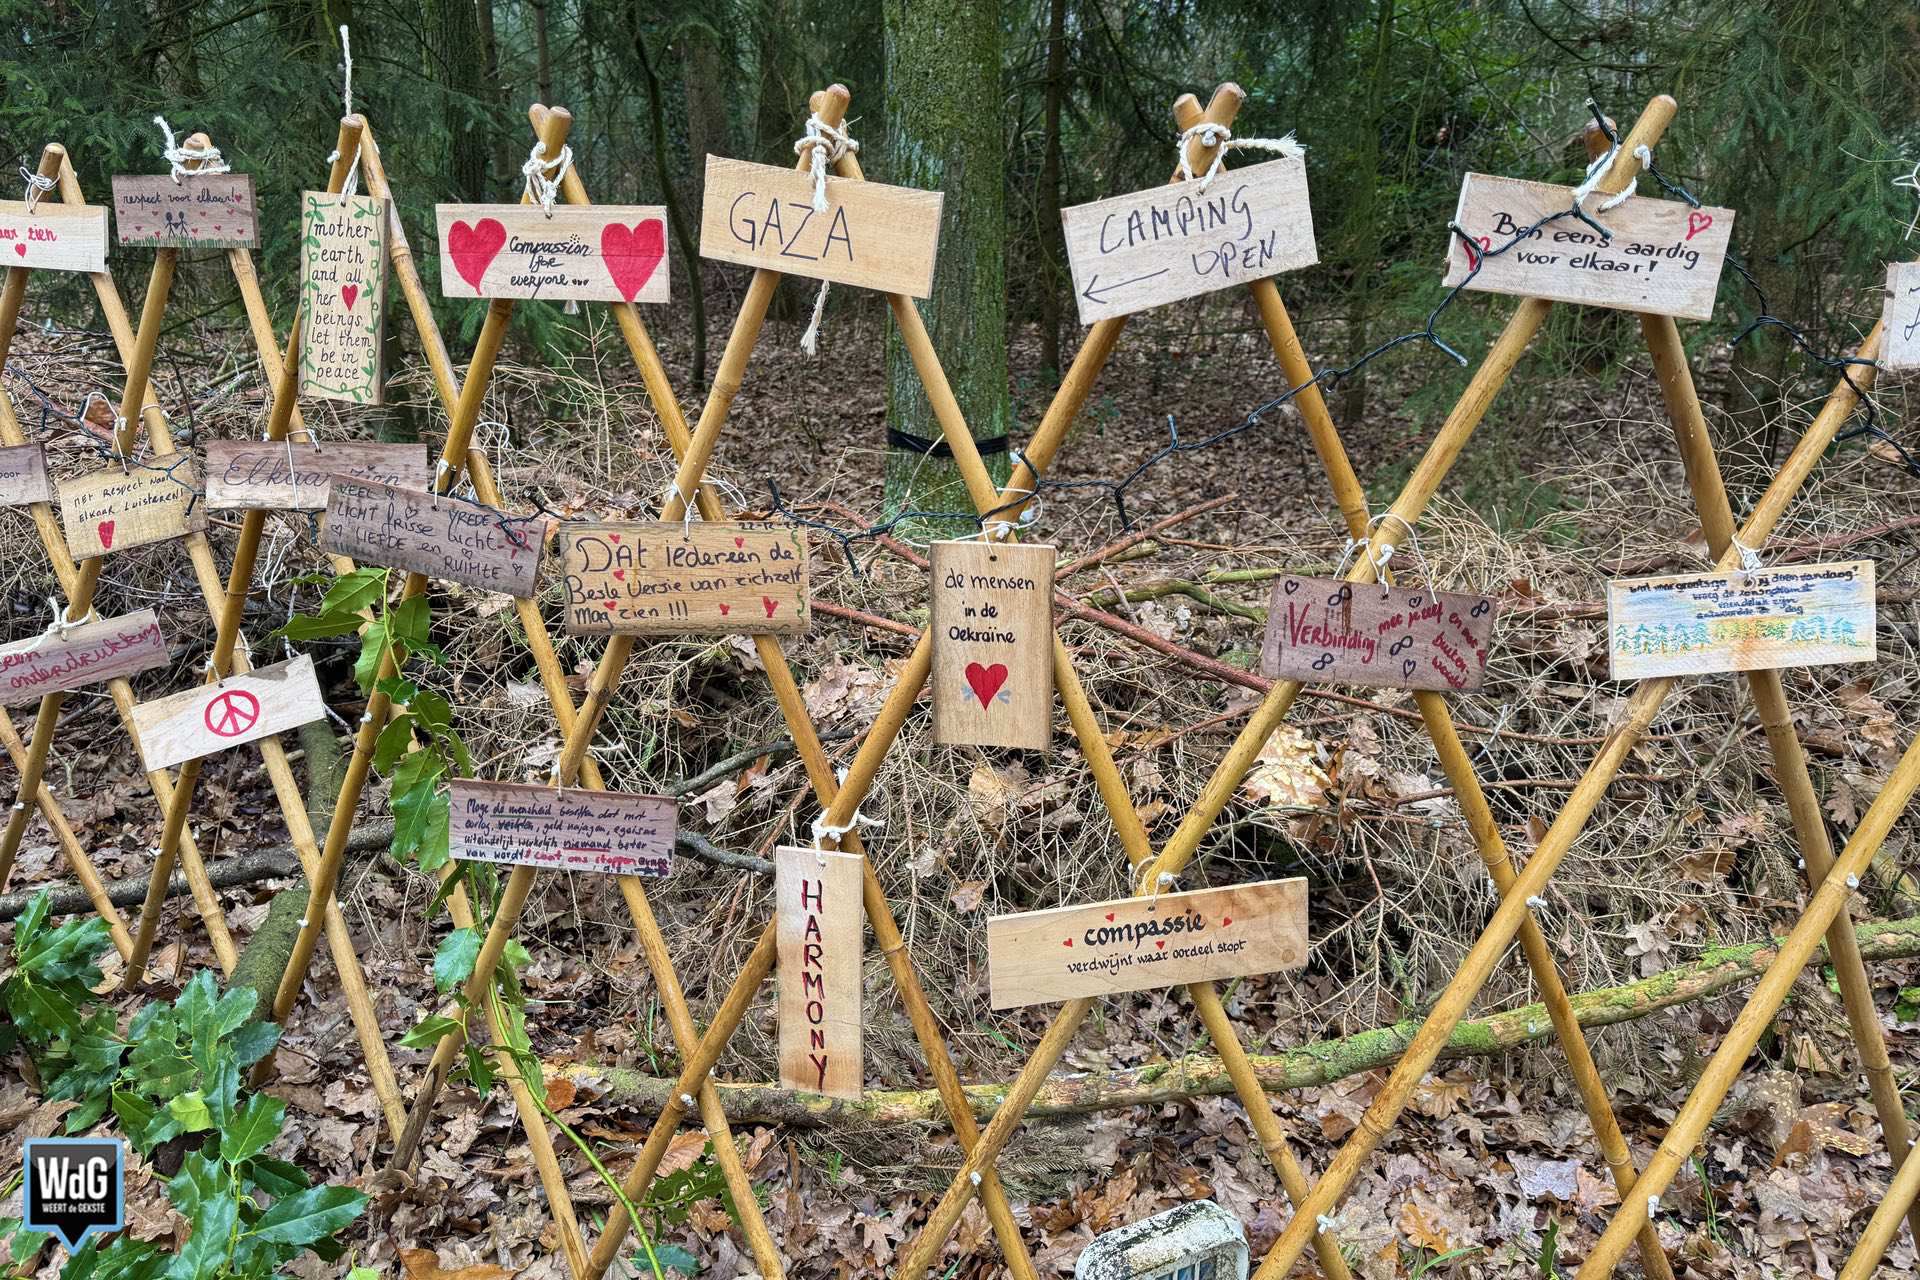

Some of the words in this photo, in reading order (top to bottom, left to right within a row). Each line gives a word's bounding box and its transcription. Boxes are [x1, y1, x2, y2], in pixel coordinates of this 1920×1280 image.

[123, 191, 161, 210] respect
[167, 194, 192, 203] voor
[313, 215, 373, 238] mother
[729, 191, 854, 262] GAZA
[1099, 184, 1253, 255] CAMPING
[509, 234, 592, 271] Compassion
[1491, 212, 1543, 241] Ben
[1553, 230, 1613, 249] eens
[1623, 241, 1702, 270] aardig
[320, 244, 365, 265] earth
[1191, 230, 1277, 277] OPEN
[311, 264, 338, 283] and
[345, 267, 363, 284] all
[1516, 251, 1558, 265] voor
[1568, 251, 1659, 282] elkaar!
[316, 288, 337, 306] her
[510, 275, 569, 299] everyone
[314, 310, 363, 336] beings
[311, 326, 330, 346] let
[338, 328, 372, 347] them
[320, 347, 336, 364] be
[341, 348, 359, 364] in
[315, 366, 360, 382] peace
[222, 452, 332, 488] Elkaar
[338, 483, 377, 501] VEEL
[448, 509, 491, 527] VREDE
[336, 505, 380, 522] LICHT
[447, 528, 498, 552] lucht
[354, 526, 407, 550] LIEFDE
[418, 542, 442, 556] en
[769, 541, 795, 562] de
[690, 578, 727, 593] van
[735, 563, 803, 586] zichzelf
[944, 567, 964, 589] de
[970, 575, 1036, 591] mensen
[617, 604, 661, 620] zien
[961, 601, 977, 618] in
[980, 602, 999, 618] de
[1784, 604, 1804, 615] dag
[949, 625, 1016, 644] Oekraïne
[466, 797, 489, 818] Moge
[492, 802, 505, 814] de
[465, 848, 487, 858] van
[567, 855, 589, 864] ons
[1083, 908, 1207, 950] compassie
[1066, 952, 1134, 977] verdwijnt
[1137, 948, 1170, 966] waar
[1171, 941, 1215, 960] oordeel
[1216, 938, 1248, 955] stopt
[800, 878, 829, 1093] HARMONY
